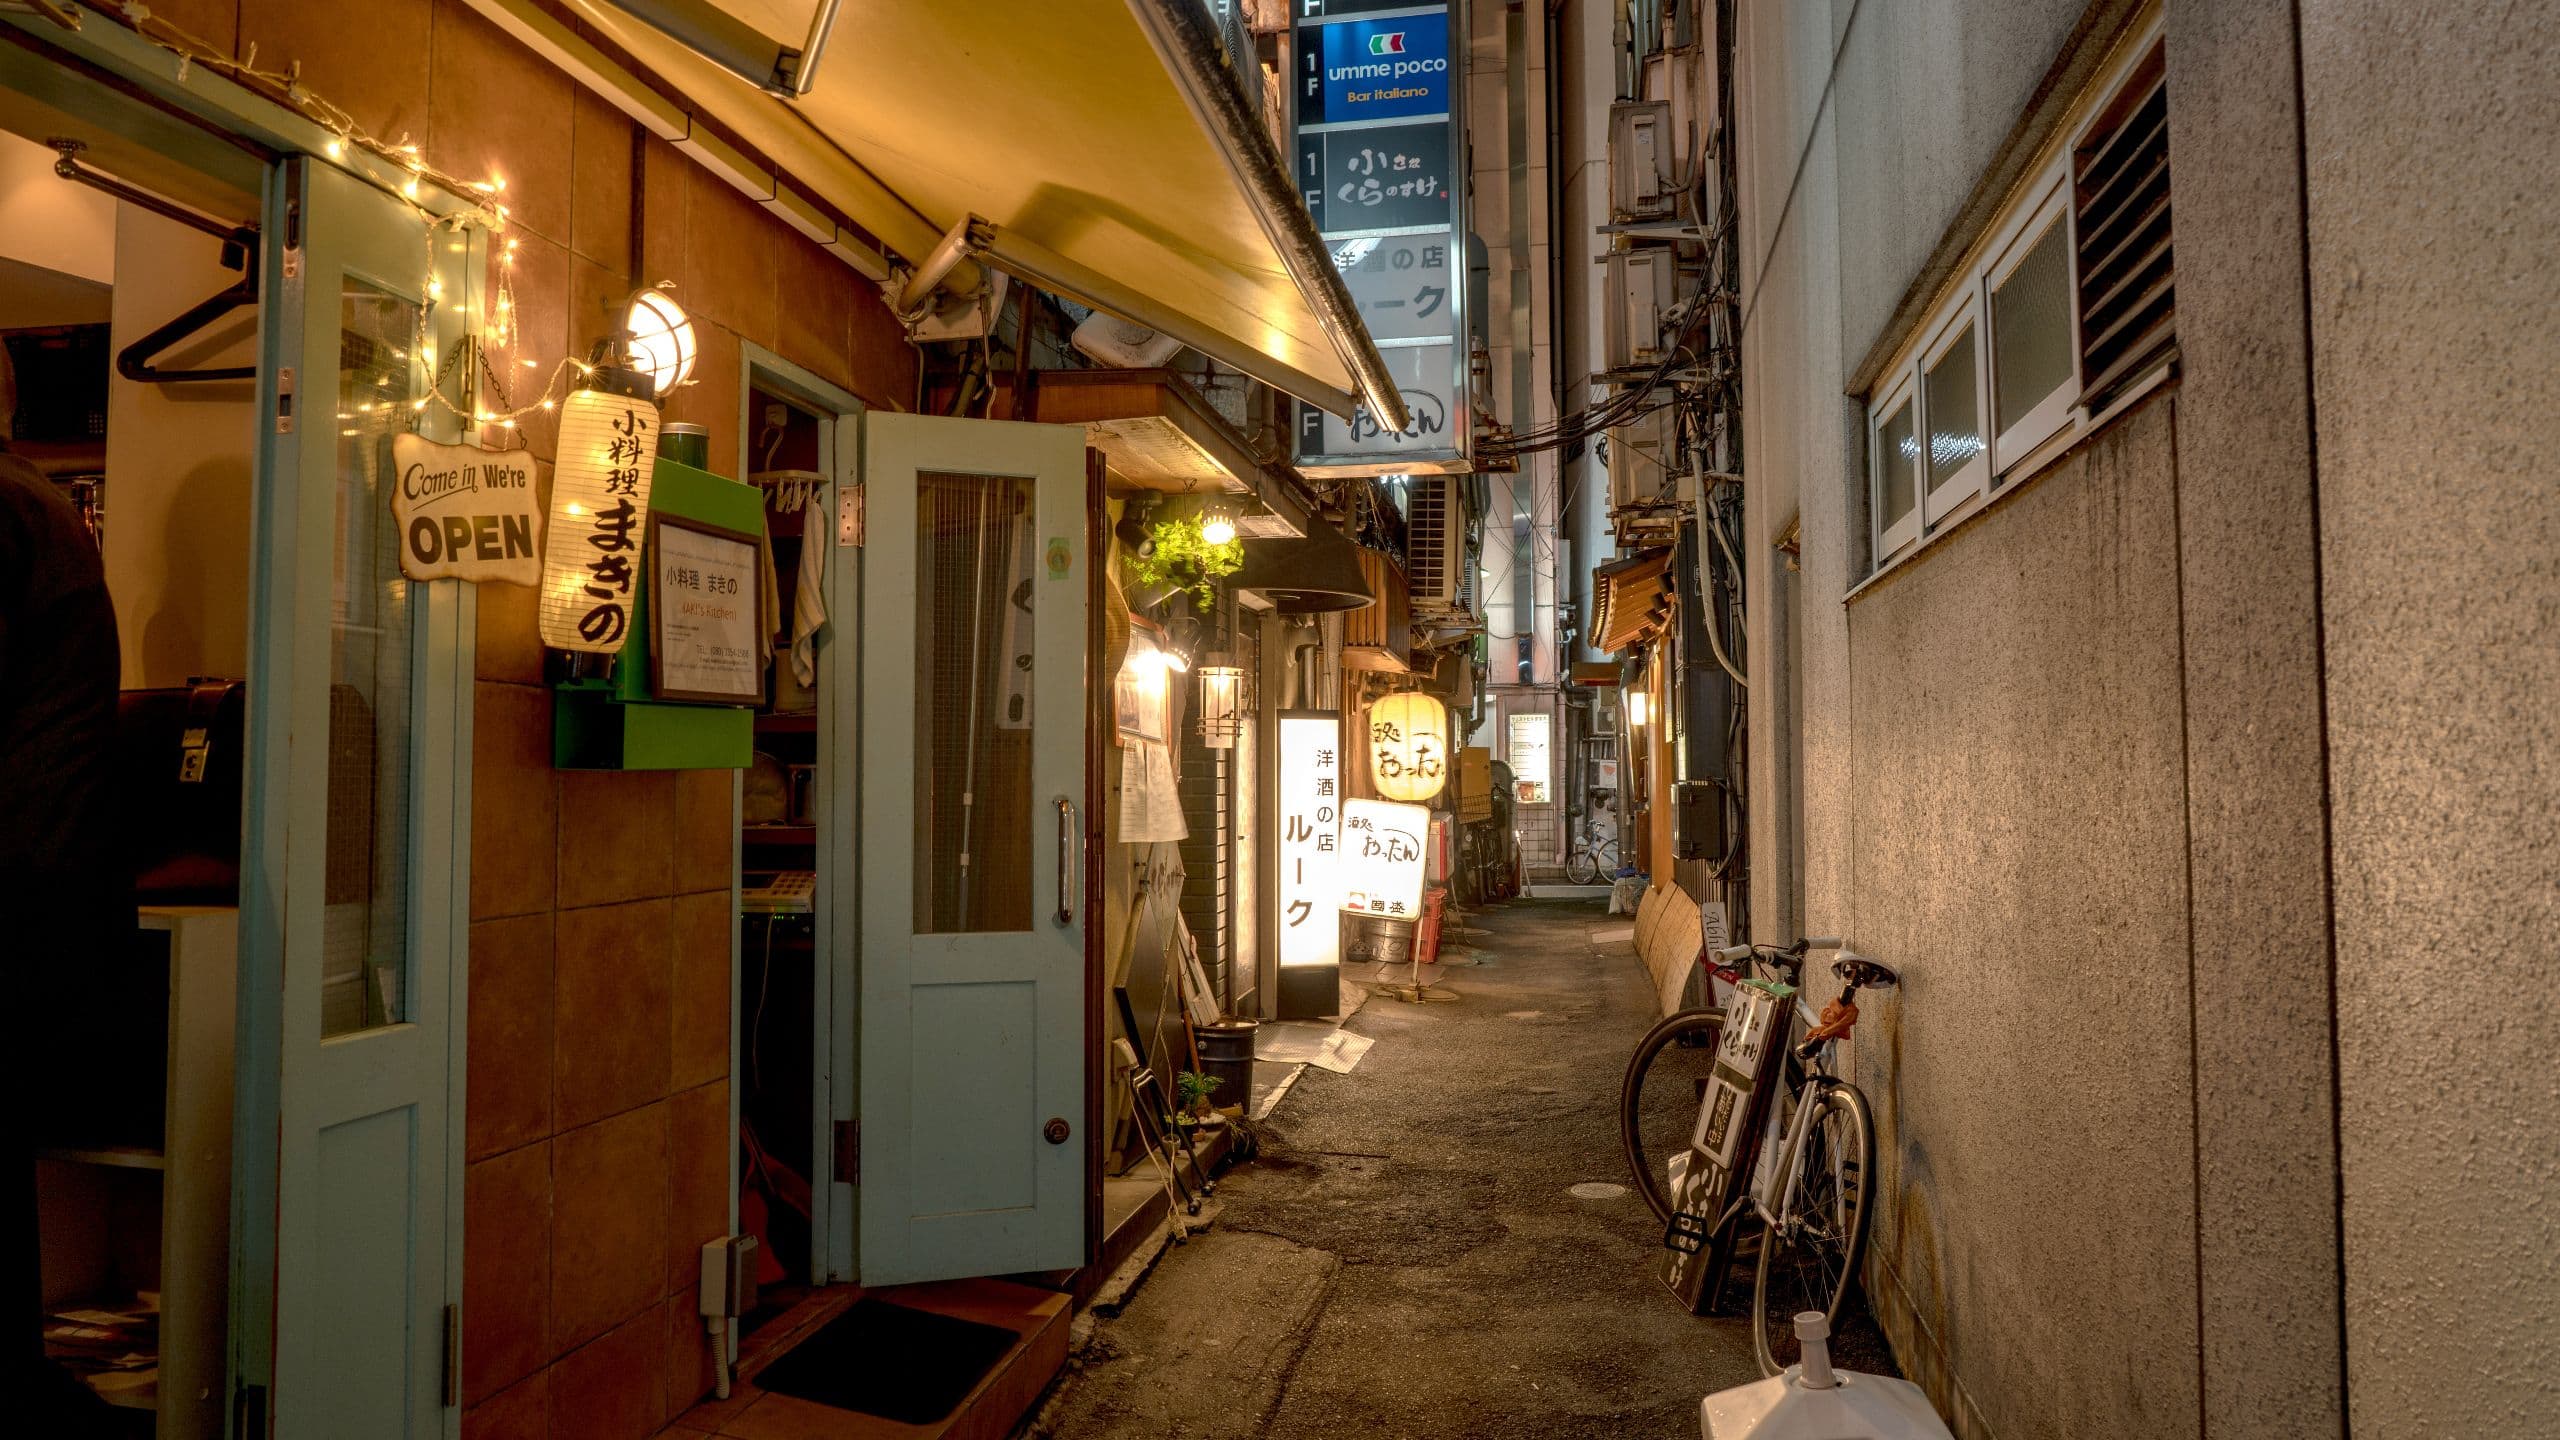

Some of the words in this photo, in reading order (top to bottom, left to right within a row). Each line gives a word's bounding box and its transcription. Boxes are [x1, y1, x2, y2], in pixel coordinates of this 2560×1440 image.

[1329, 62, 1390, 82] umme
[1394, 57, 1448, 79] poco
[1347, 91, 1371, 103] Bar
[1374, 87, 1429, 101] italiano
[1347, 148, 1422, 176] 小さな
[1337, 175, 1438, 207] くらのすけ
[1358, 285, 1446, 319] ーク
[1351, 389, 1445, 443] おん
[403, 462, 458, 502] Come
[462, 463, 479, 494] in
[483, 463, 526, 490] We're
[408, 513, 535, 565] OPEN
[577, 408, 647, 646] 小料理まきの
[665, 565, 701, 592] 小料理
[706, 573, 739, 596] まきの
[1316, 748, 1335, 853] 洋酒の店
[1347, 816, 1374, 833] 酒処
[1285, 814, 1314, 929] ルーク
